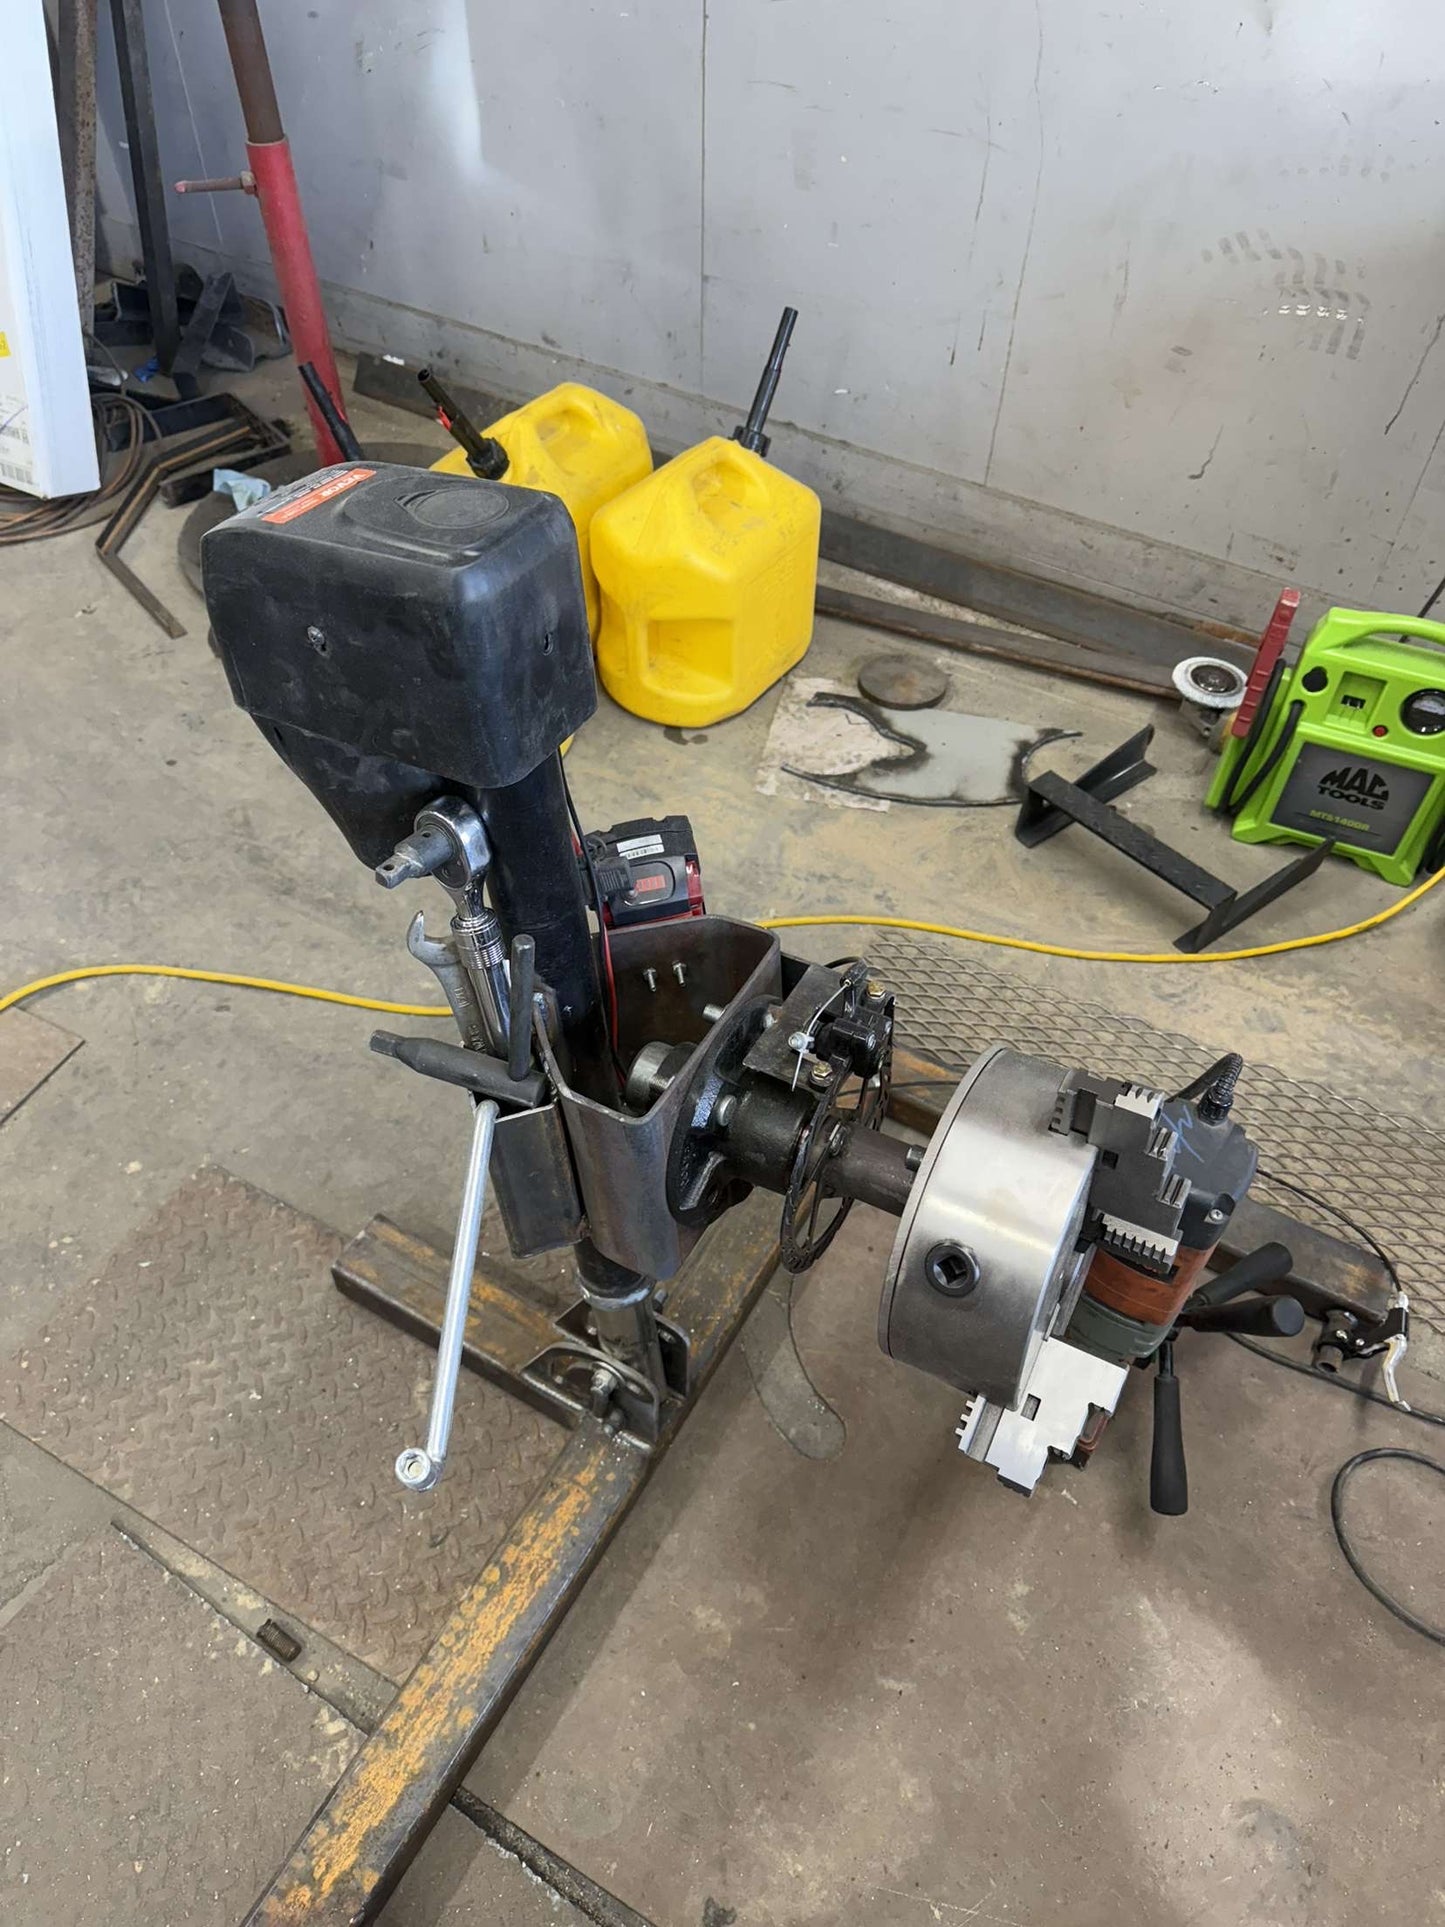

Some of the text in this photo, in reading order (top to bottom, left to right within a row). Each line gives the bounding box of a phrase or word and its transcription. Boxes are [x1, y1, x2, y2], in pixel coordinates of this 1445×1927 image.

[321, 474, 364, 497] VEVOR
[1319, 767, 1389, 801] MAC
[1317, 785, 1385, 810] TOOLS
